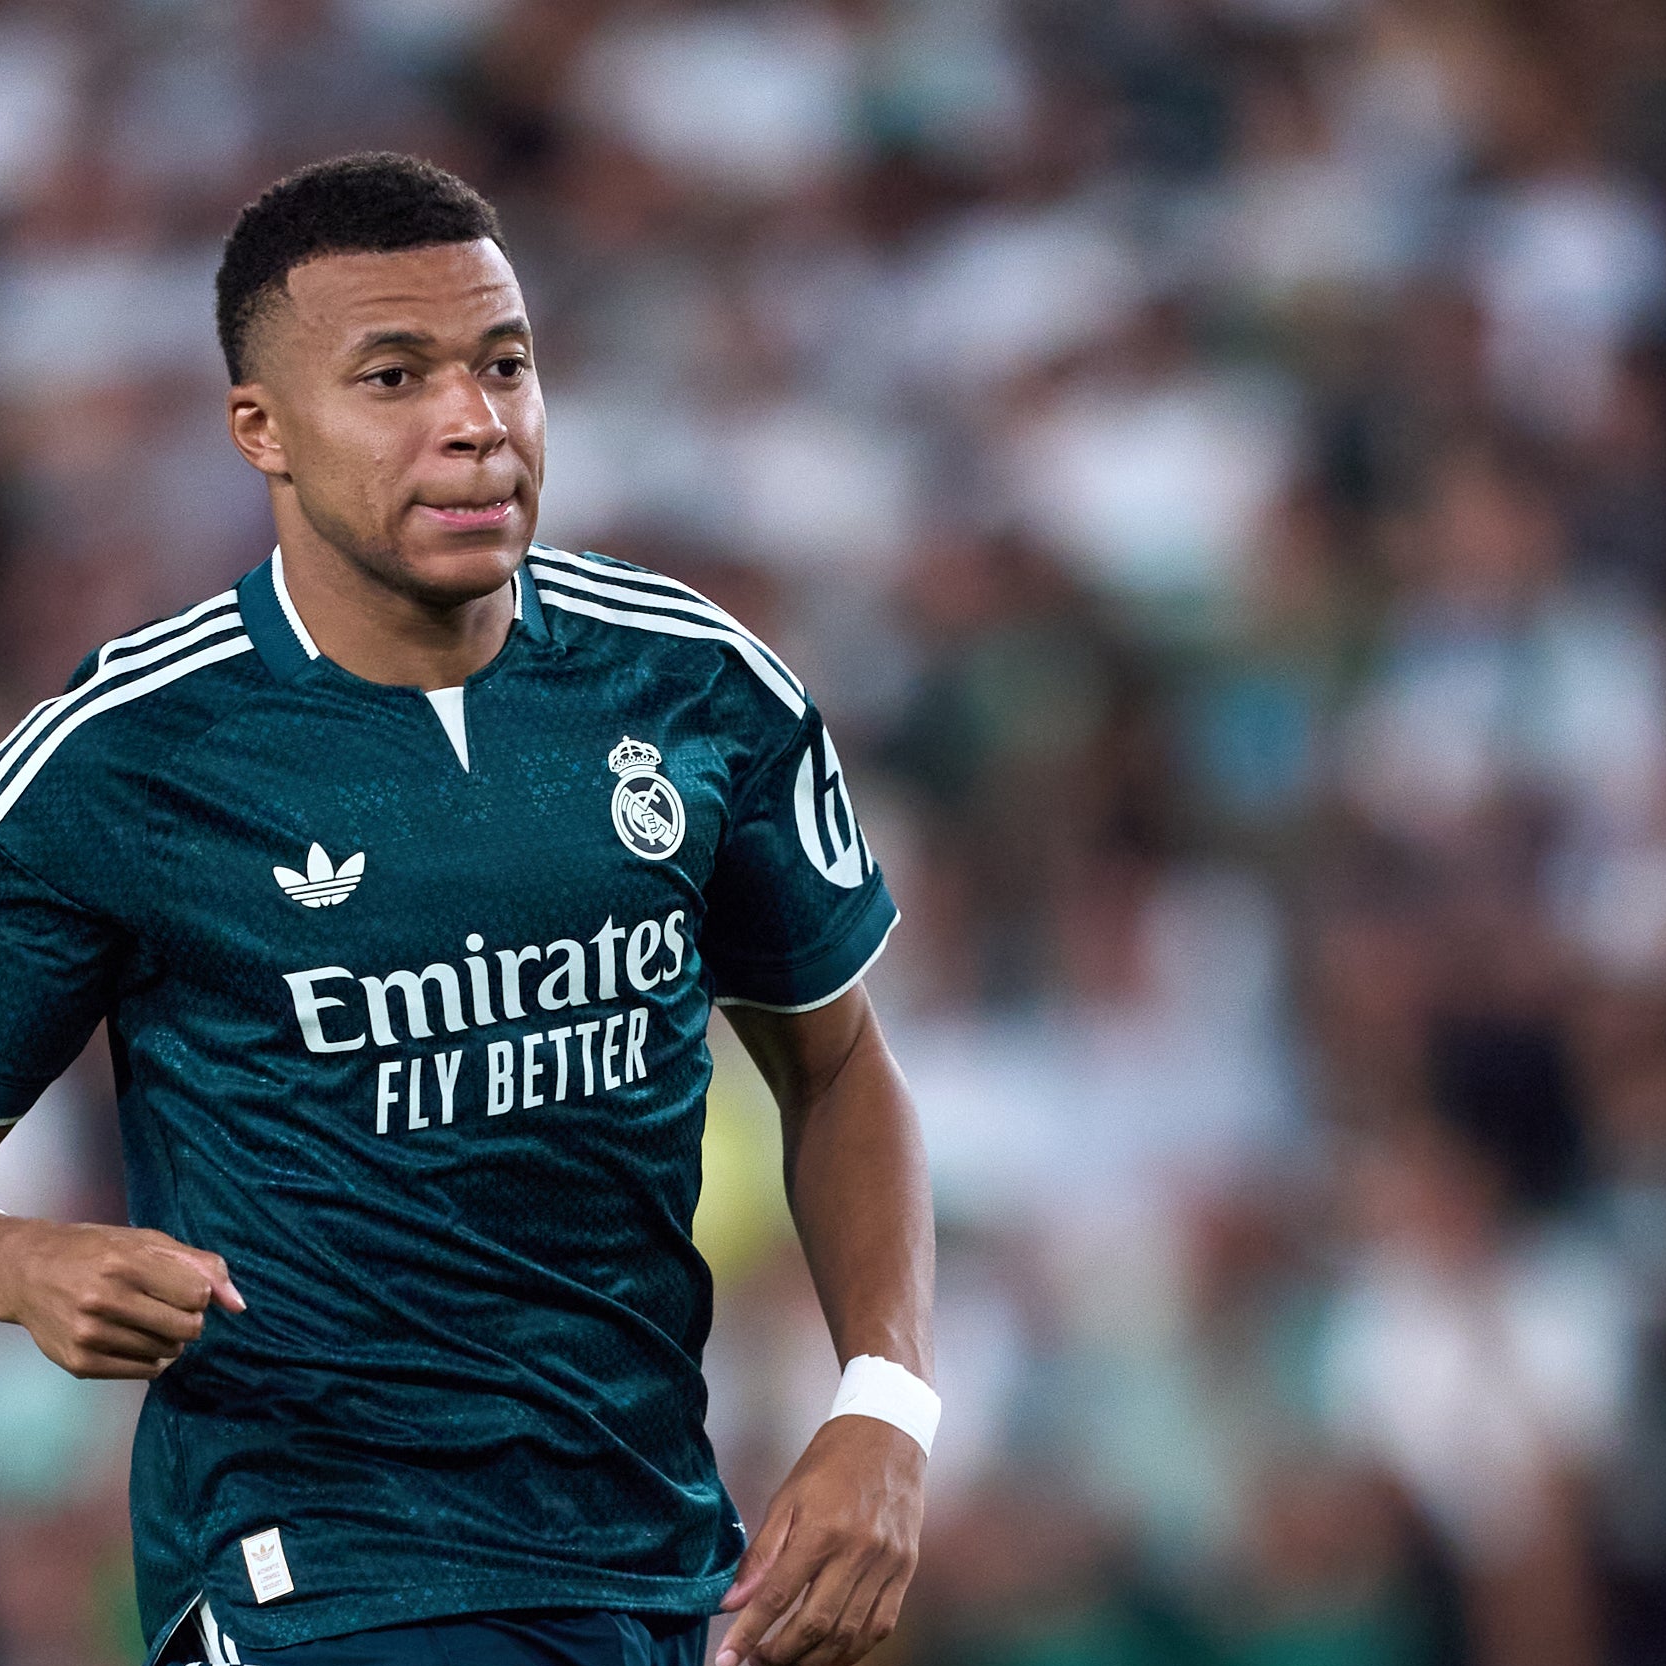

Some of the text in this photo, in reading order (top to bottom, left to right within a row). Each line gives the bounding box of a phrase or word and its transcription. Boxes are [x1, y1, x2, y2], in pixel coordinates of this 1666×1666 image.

[282, 910, 685, 1053] Emirates
[376, 1007, 649, 1135] FLY BETTER
